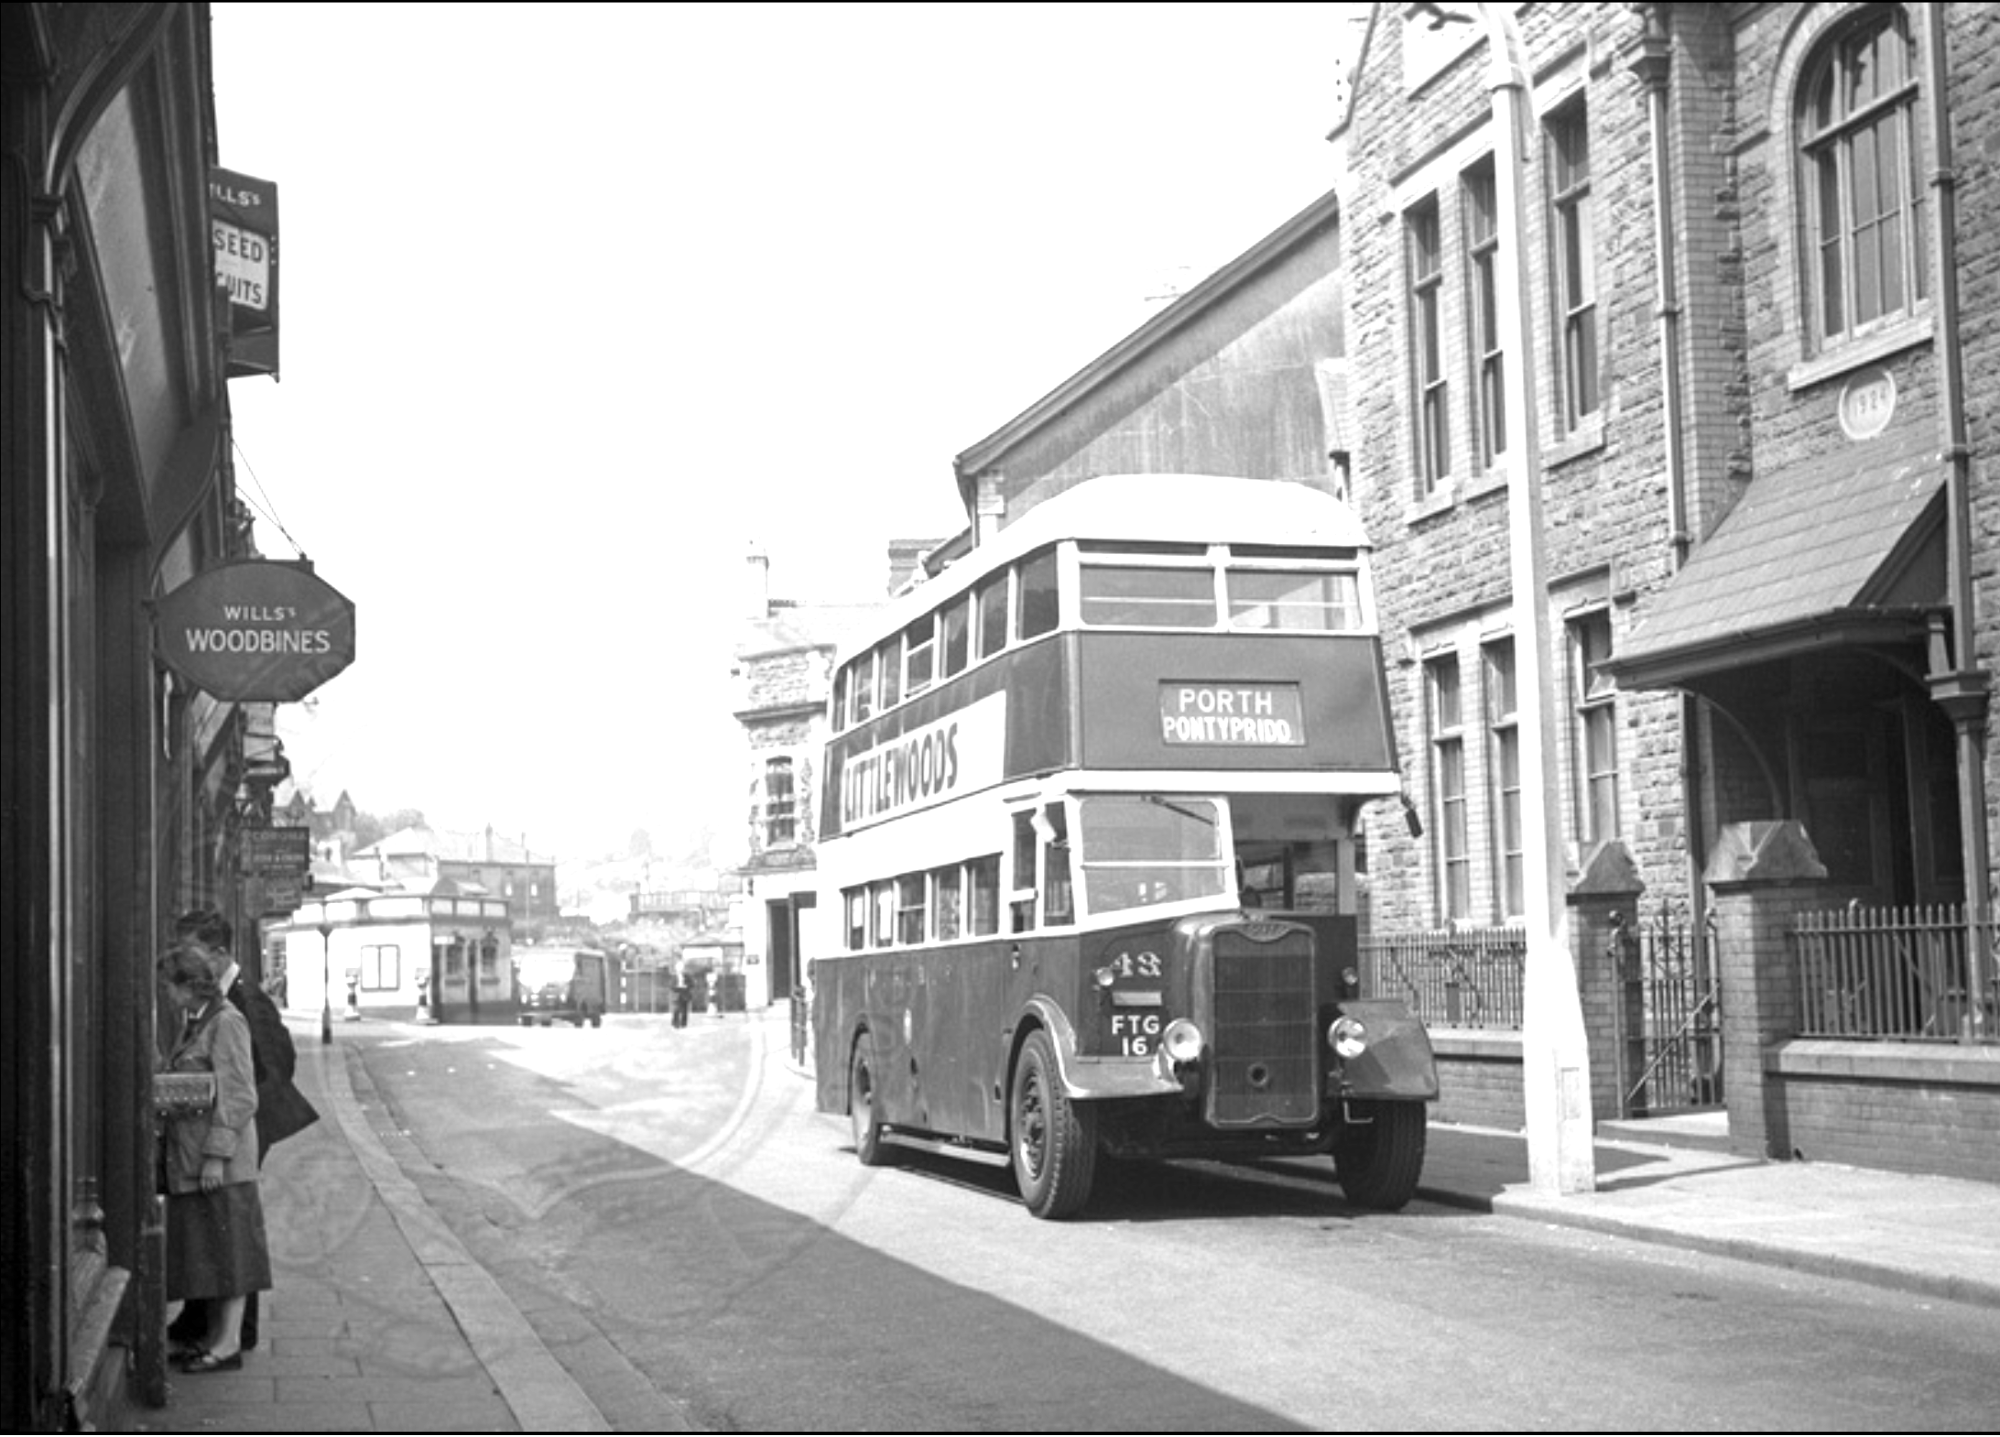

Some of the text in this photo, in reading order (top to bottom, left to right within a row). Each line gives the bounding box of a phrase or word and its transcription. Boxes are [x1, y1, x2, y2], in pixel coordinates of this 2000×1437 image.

[185, 628, 331, 653] WOODBINES
[1178, 688, 1273, 715] PORTH
[844, 721, 958, 824] LITTLEWOODS
[1111, 1014, 1160, 1035] FTG
[1121, 1036, 1148, 1056] 16
